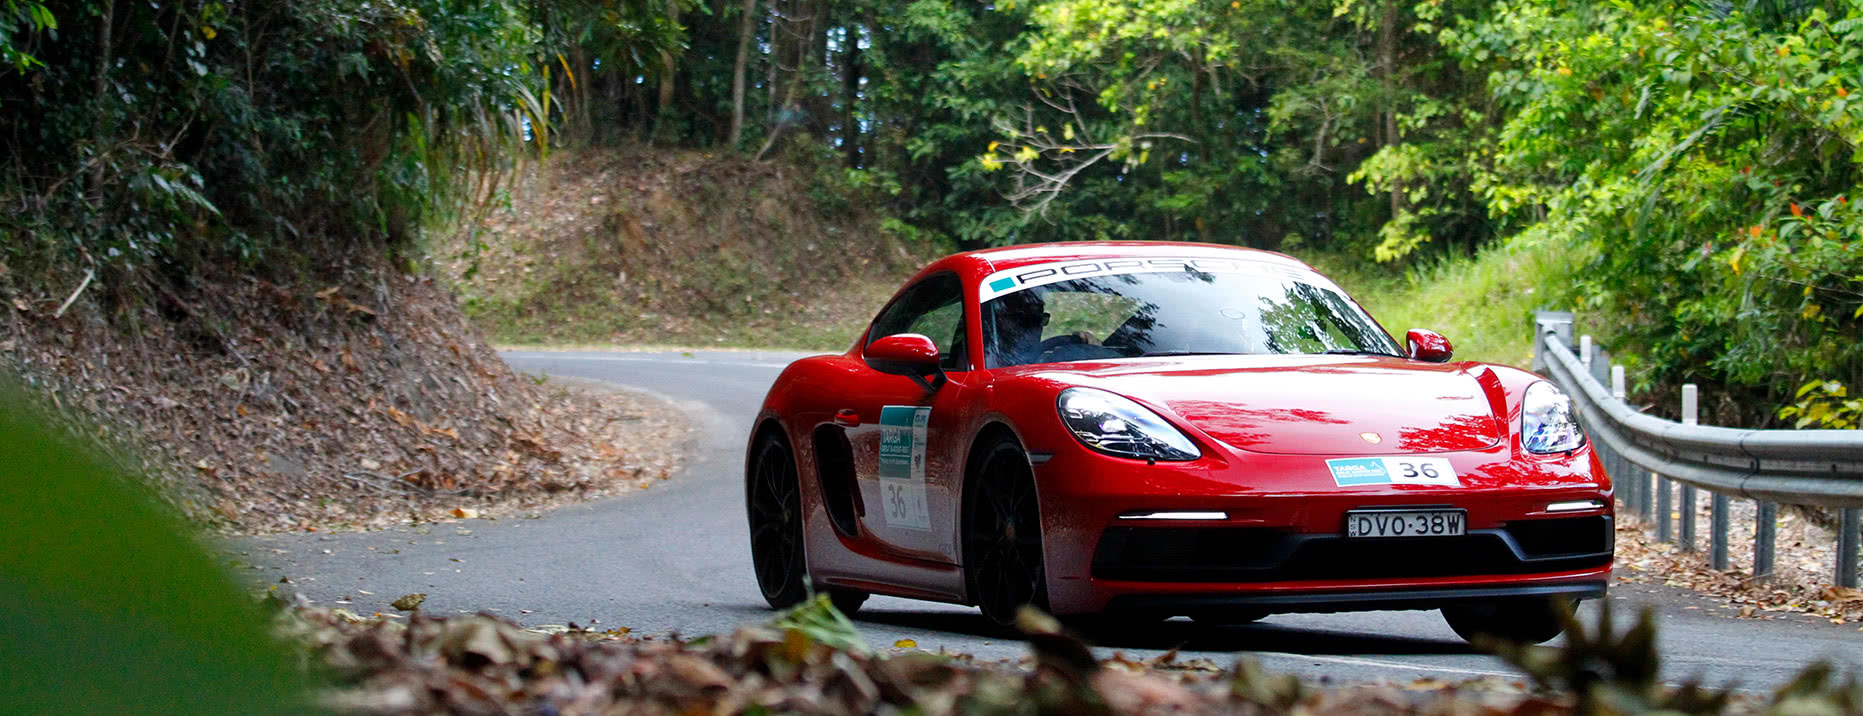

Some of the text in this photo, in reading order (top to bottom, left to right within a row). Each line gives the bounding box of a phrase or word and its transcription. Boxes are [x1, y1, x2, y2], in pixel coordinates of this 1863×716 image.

[882, 428, 902, 443] TARGA
[1333, 464, 1367, 474] TARGA
[1399, 462, 1439, 478] 36
[888, 484, 907, 518] 36
